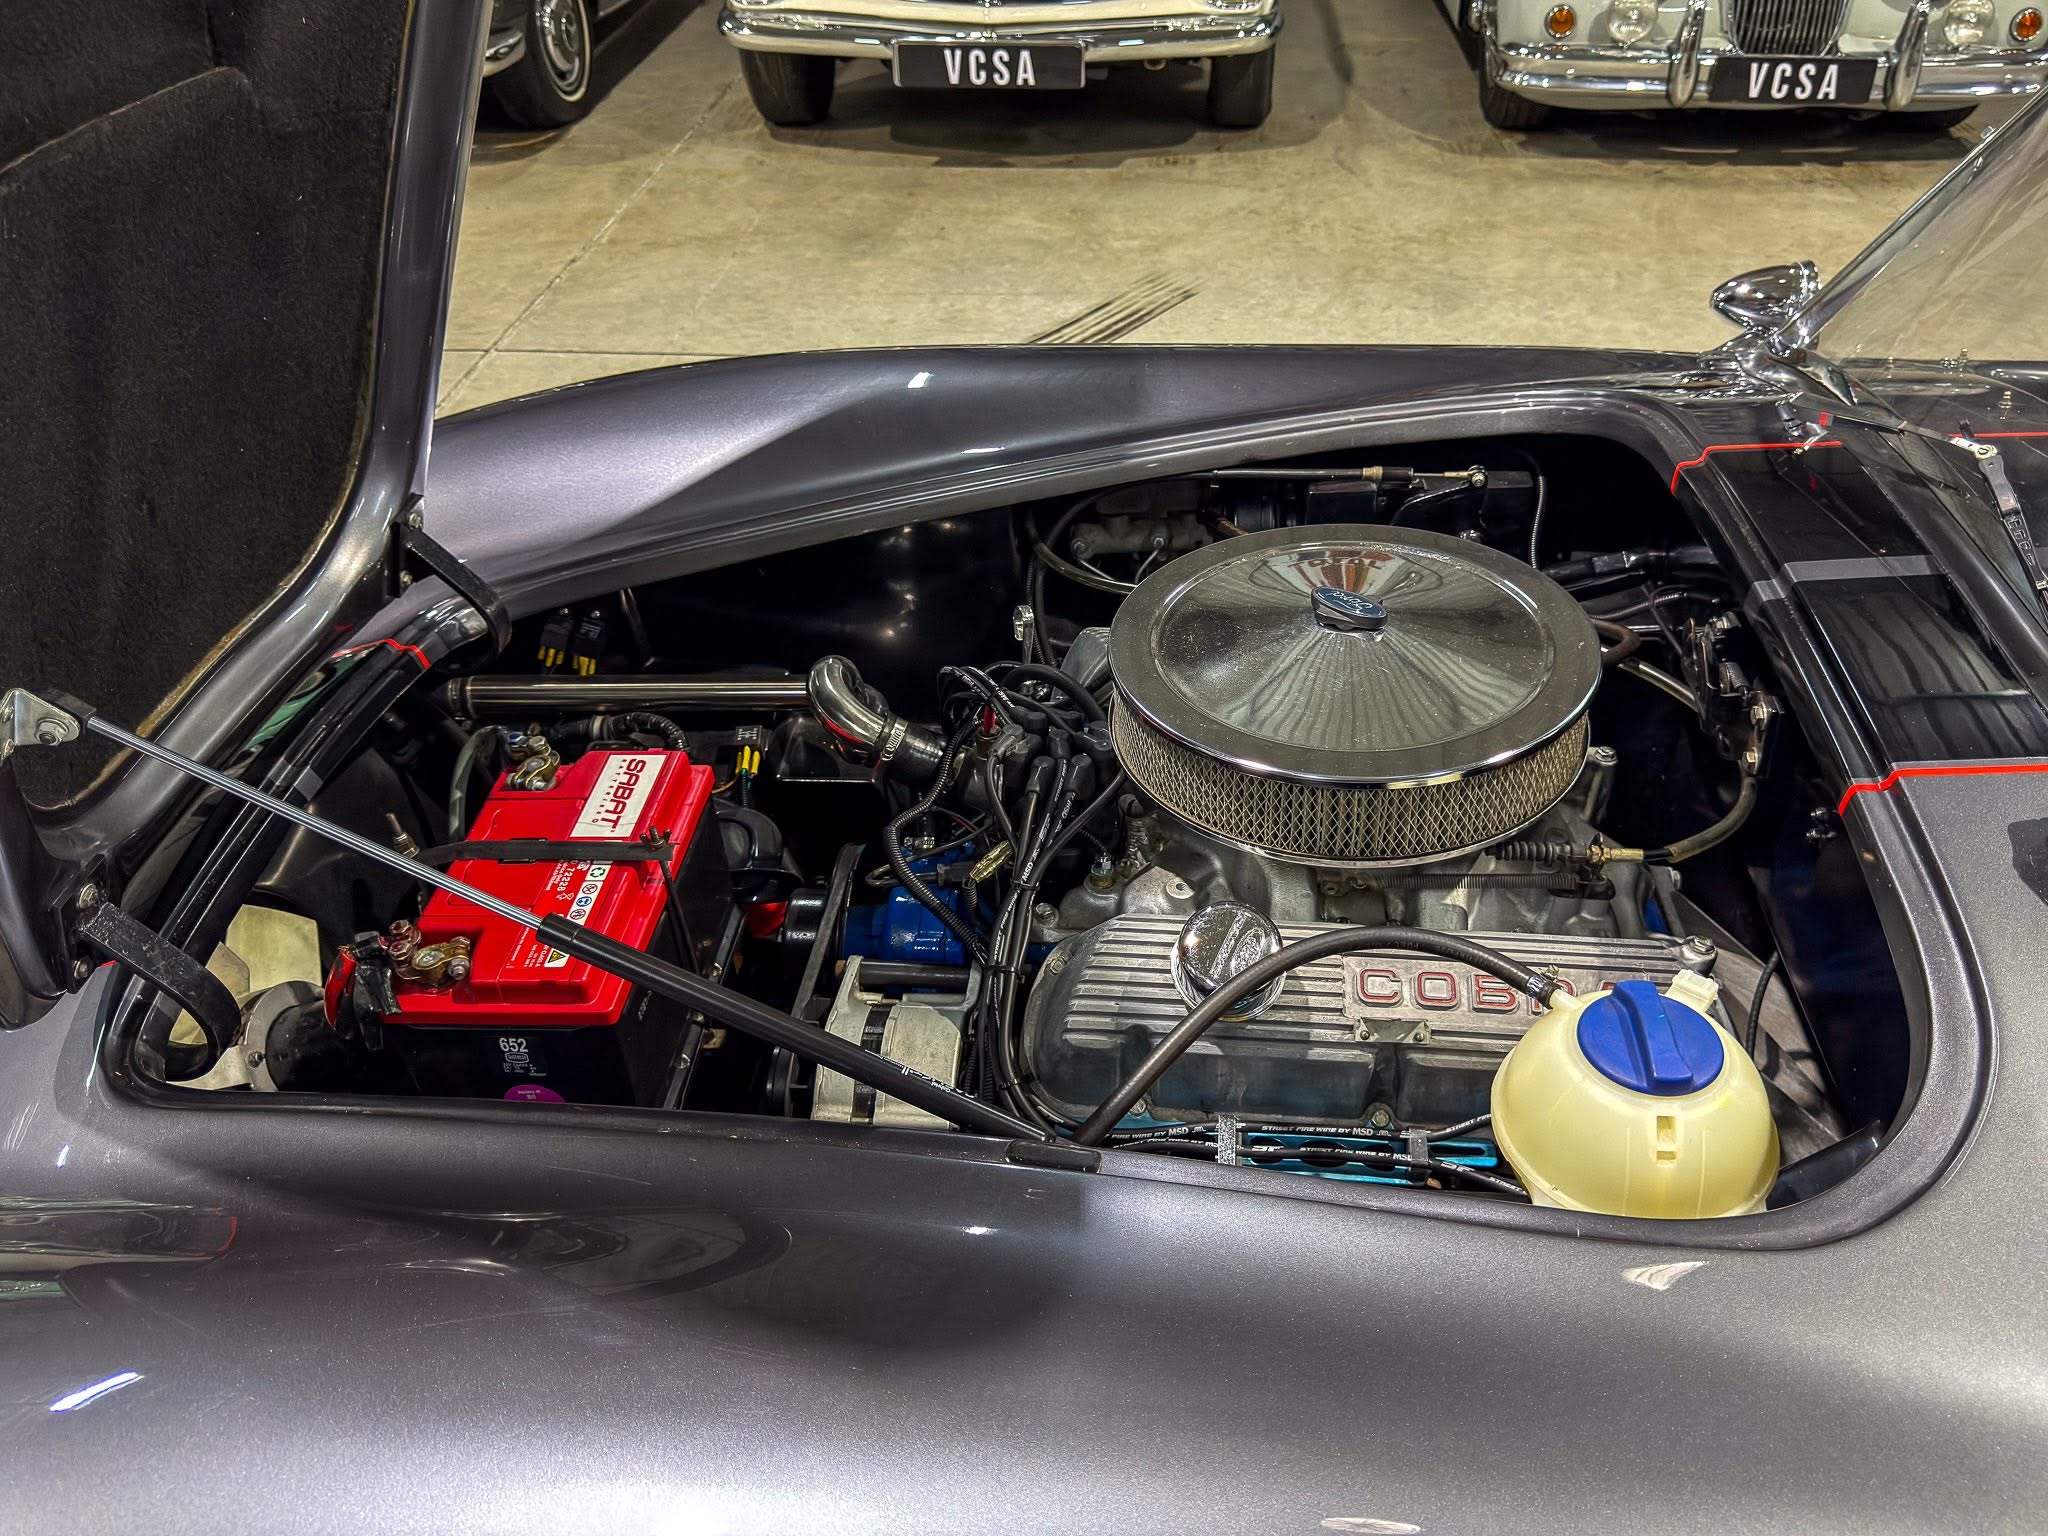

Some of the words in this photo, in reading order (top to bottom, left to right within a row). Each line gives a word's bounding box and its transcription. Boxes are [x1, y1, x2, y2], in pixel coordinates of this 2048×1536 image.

[943, 48, 1036, 86] VCSA
[1748, 62, 1839, 100] VCSA
[1327, 590, 1373, 613] Ford
[601, 758, 647, 829] SABAT
[1021, 861, 1034, 881] MSD
[499, 1037, 529, 1053] 652
[1168, 1126, 1189, 1137] MSD
[1352, 1127, 1374, 1136] MSD
